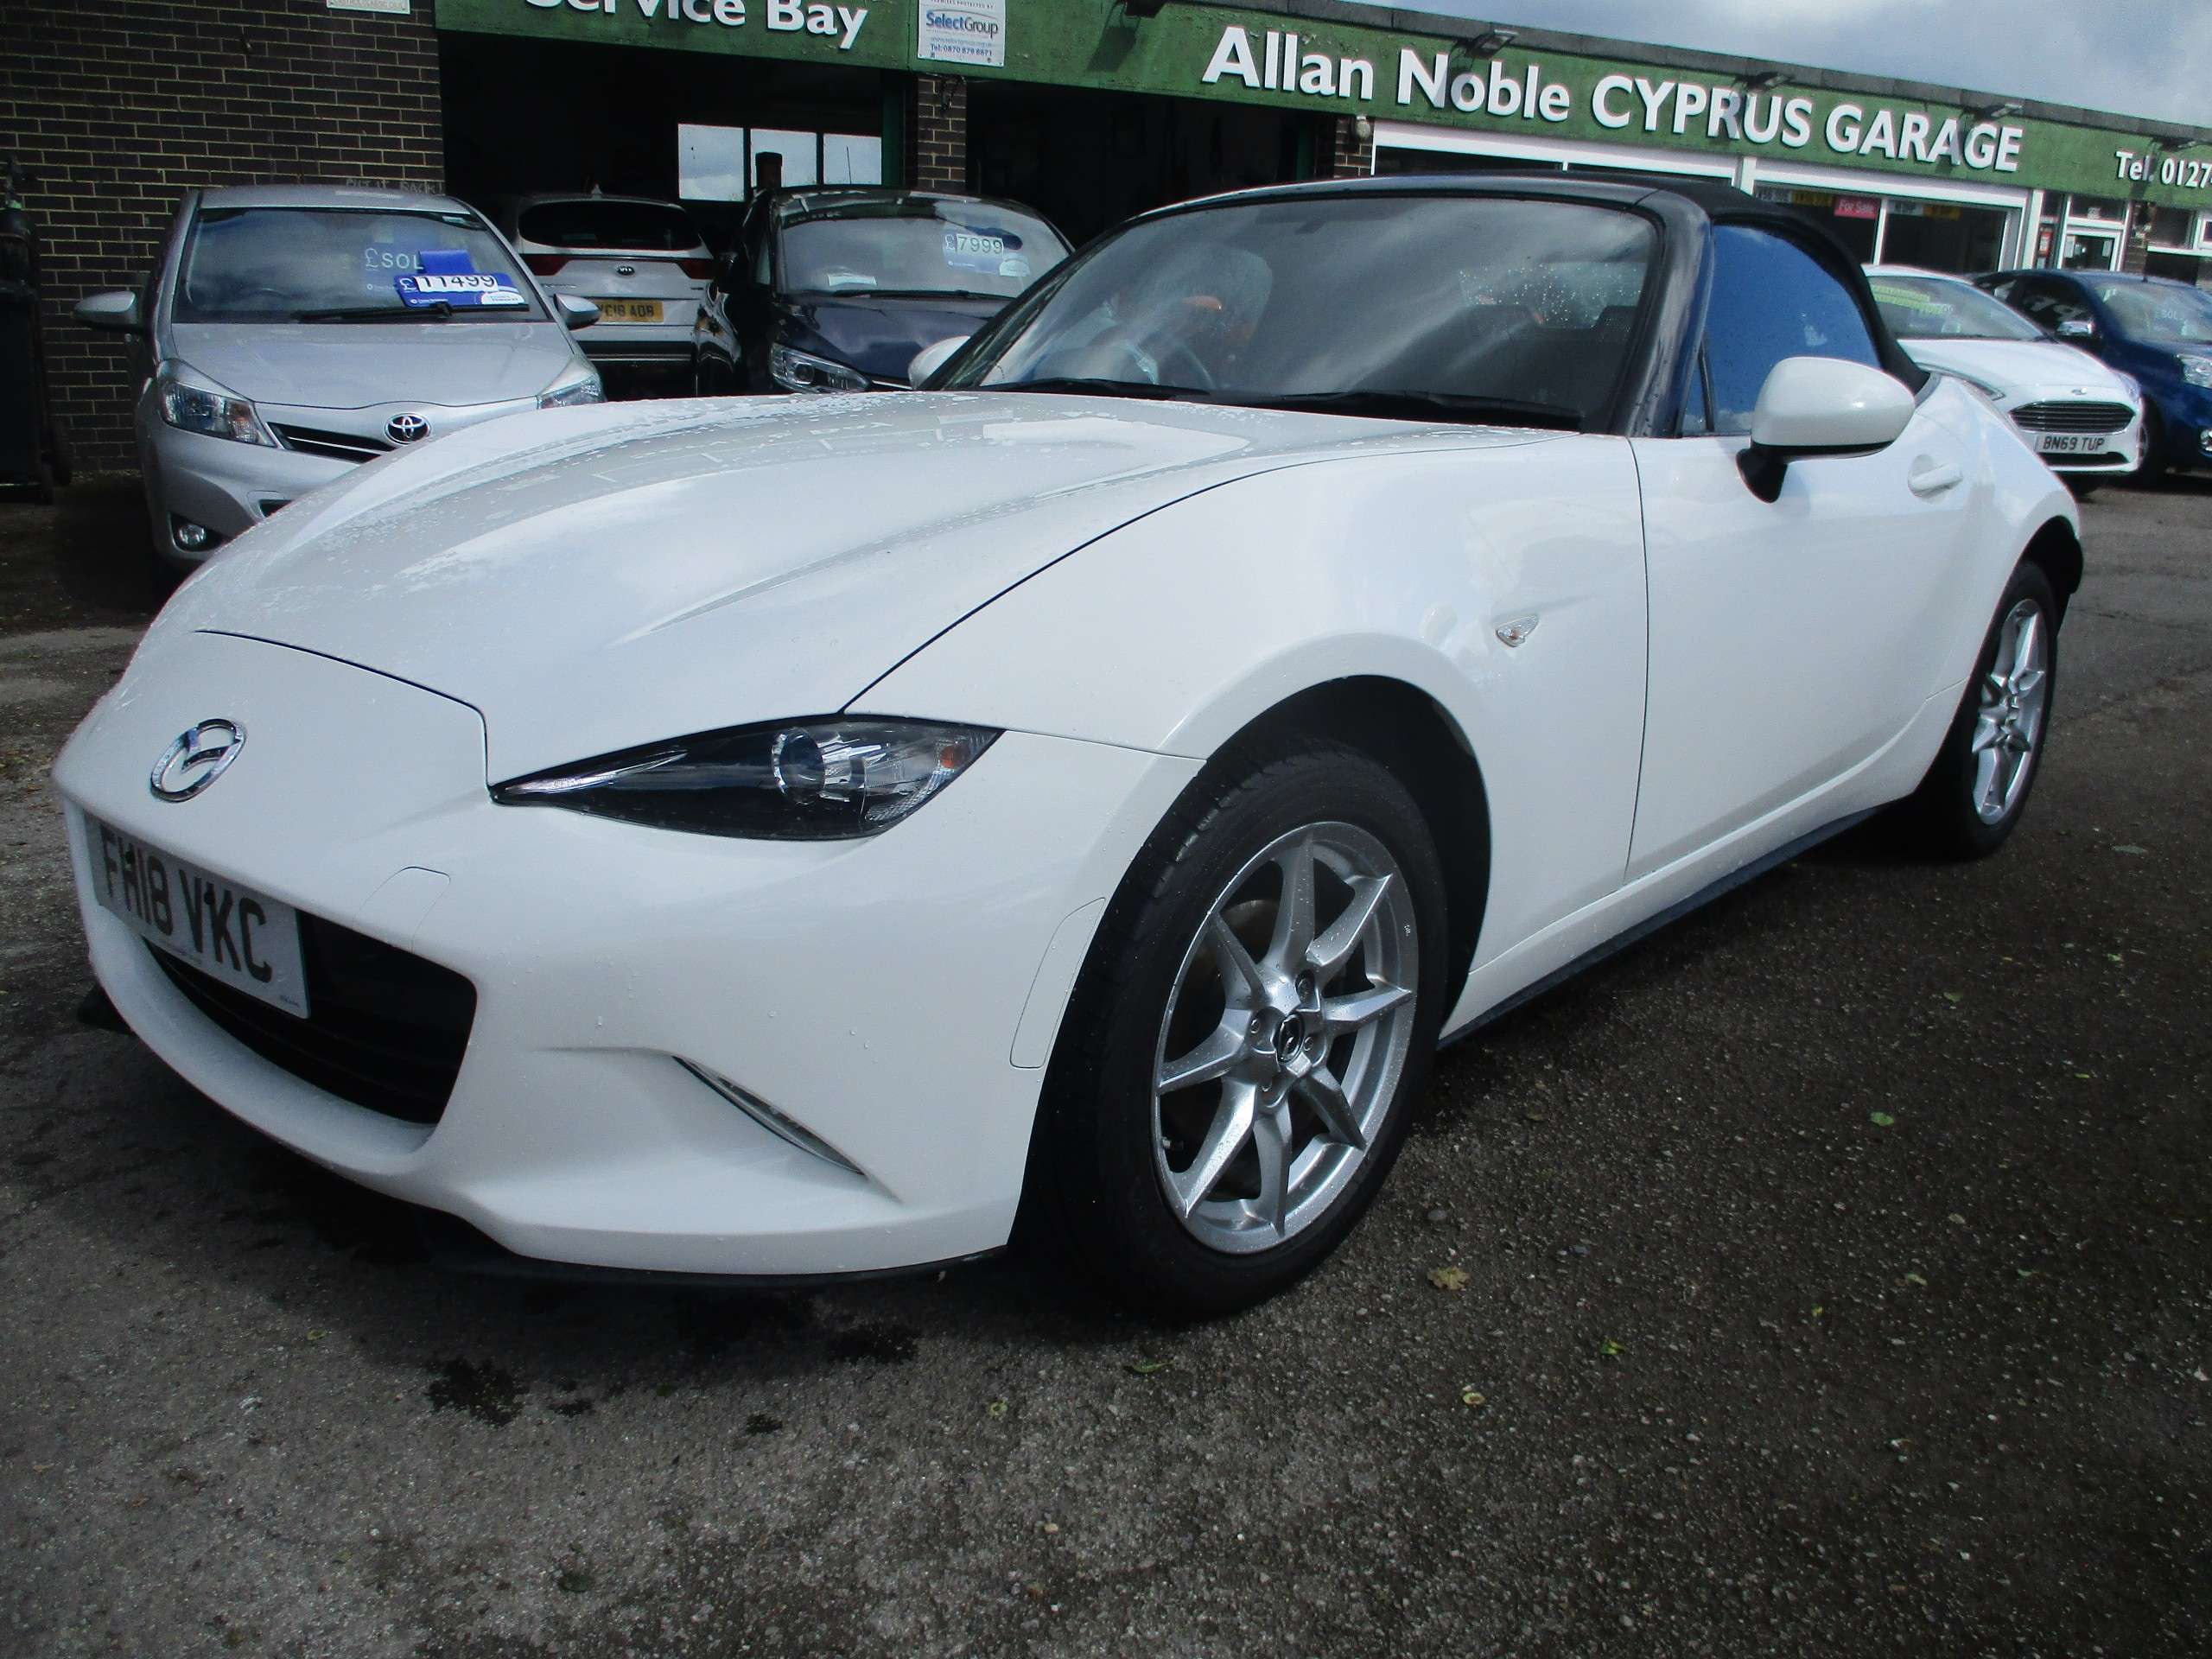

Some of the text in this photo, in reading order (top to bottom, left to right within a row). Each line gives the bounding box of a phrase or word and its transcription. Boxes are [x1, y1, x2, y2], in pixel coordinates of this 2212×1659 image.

[767, 0, 868, 50] Bay
[925, 10, 999, 39] SelectGroup
[1201, 26, 2024, 172] Allan Noble CYPRUS GARAGE
[2161, 157, 2212, 188] 0127
[2043, 435, 2105, 450] BN69 TUP
[100, 823, 273, 983] FH18 VKC
